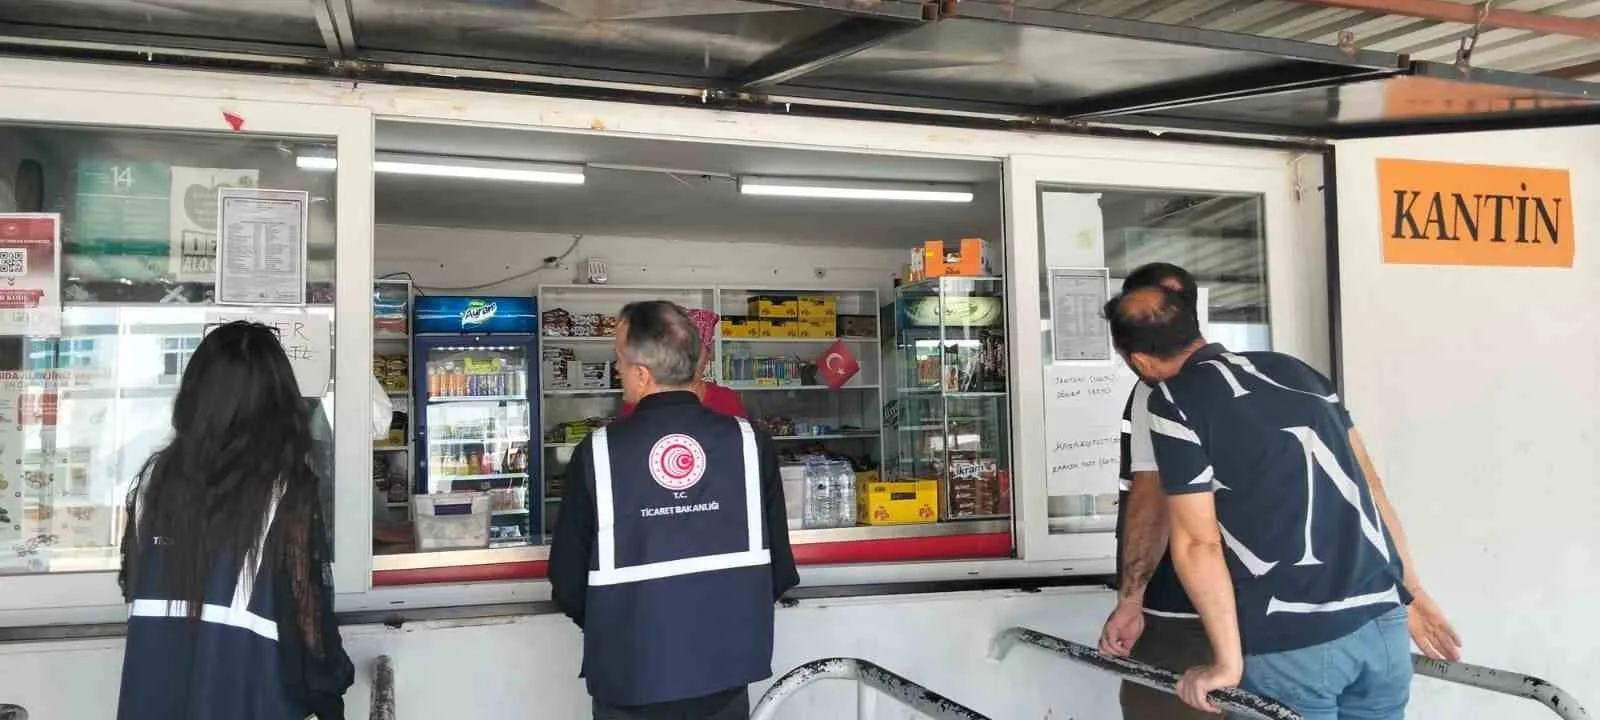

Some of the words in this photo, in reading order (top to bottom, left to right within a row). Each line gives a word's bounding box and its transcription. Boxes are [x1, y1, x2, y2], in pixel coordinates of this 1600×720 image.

[110, 166, 132, 187] 14
[1392, 182, 1562, 244] KANTİN
[641, 506, 674, 517] TİCARET
[675, 500, 720, 514] BAKANLIĞI
